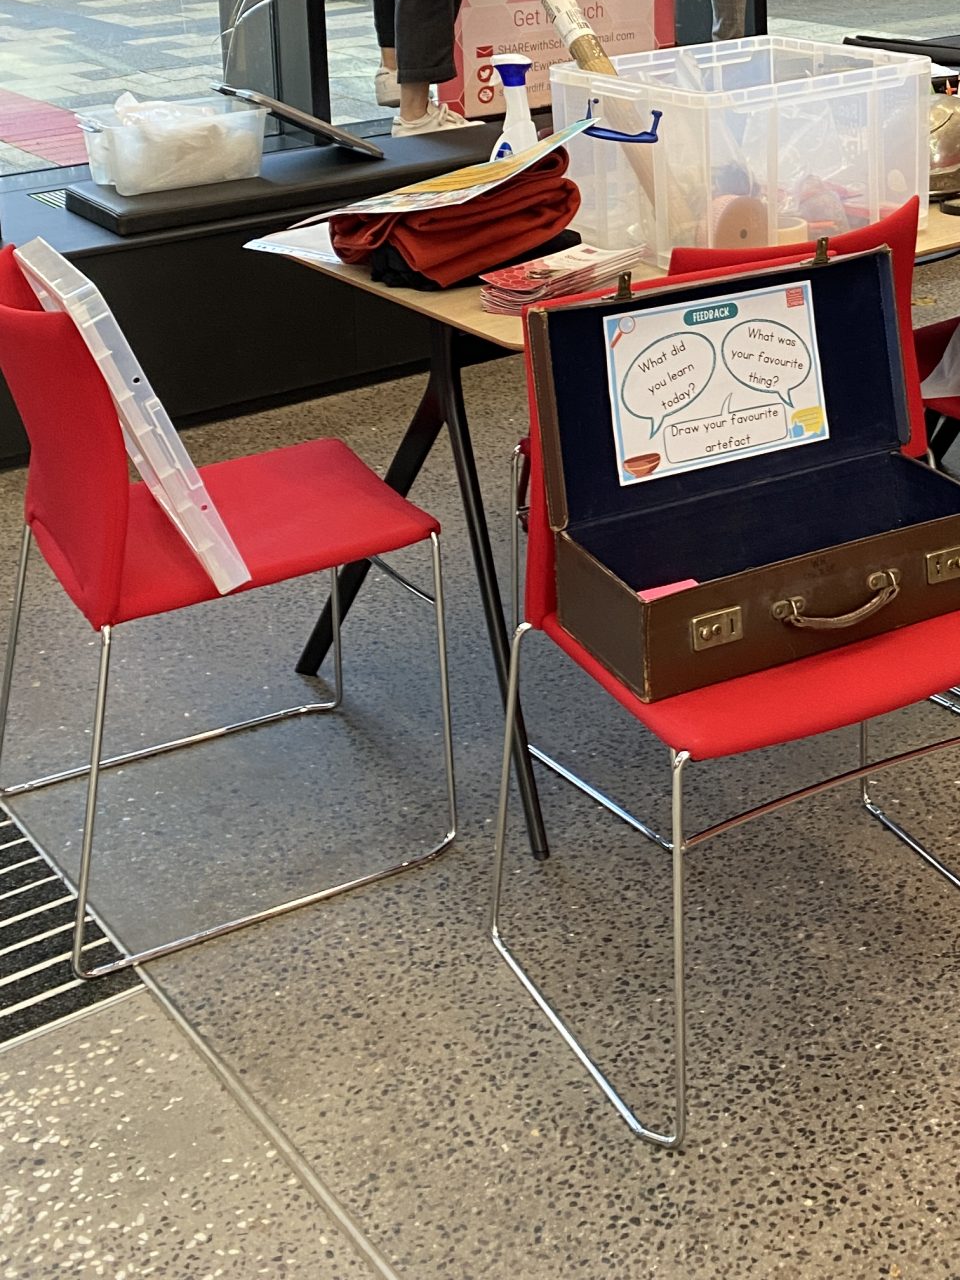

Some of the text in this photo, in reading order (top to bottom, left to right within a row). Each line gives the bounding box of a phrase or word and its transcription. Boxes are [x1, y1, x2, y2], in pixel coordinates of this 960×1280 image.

[513, 10, 540, 27] Get
[692, 306, 730, 323] FEEDBACK
[748, 327, 797, 347] What was
[637, 341, 686, 374] What did
[731, 349, 804, 370] your favourite
[648, 363, 695, 395] you learn
[749, 372, 780, 389] thing?
[662, 382, 696, 410] today?
[671, 408, 779, 437] Draw your favourite
[705, 435, 751, 453] artefact
